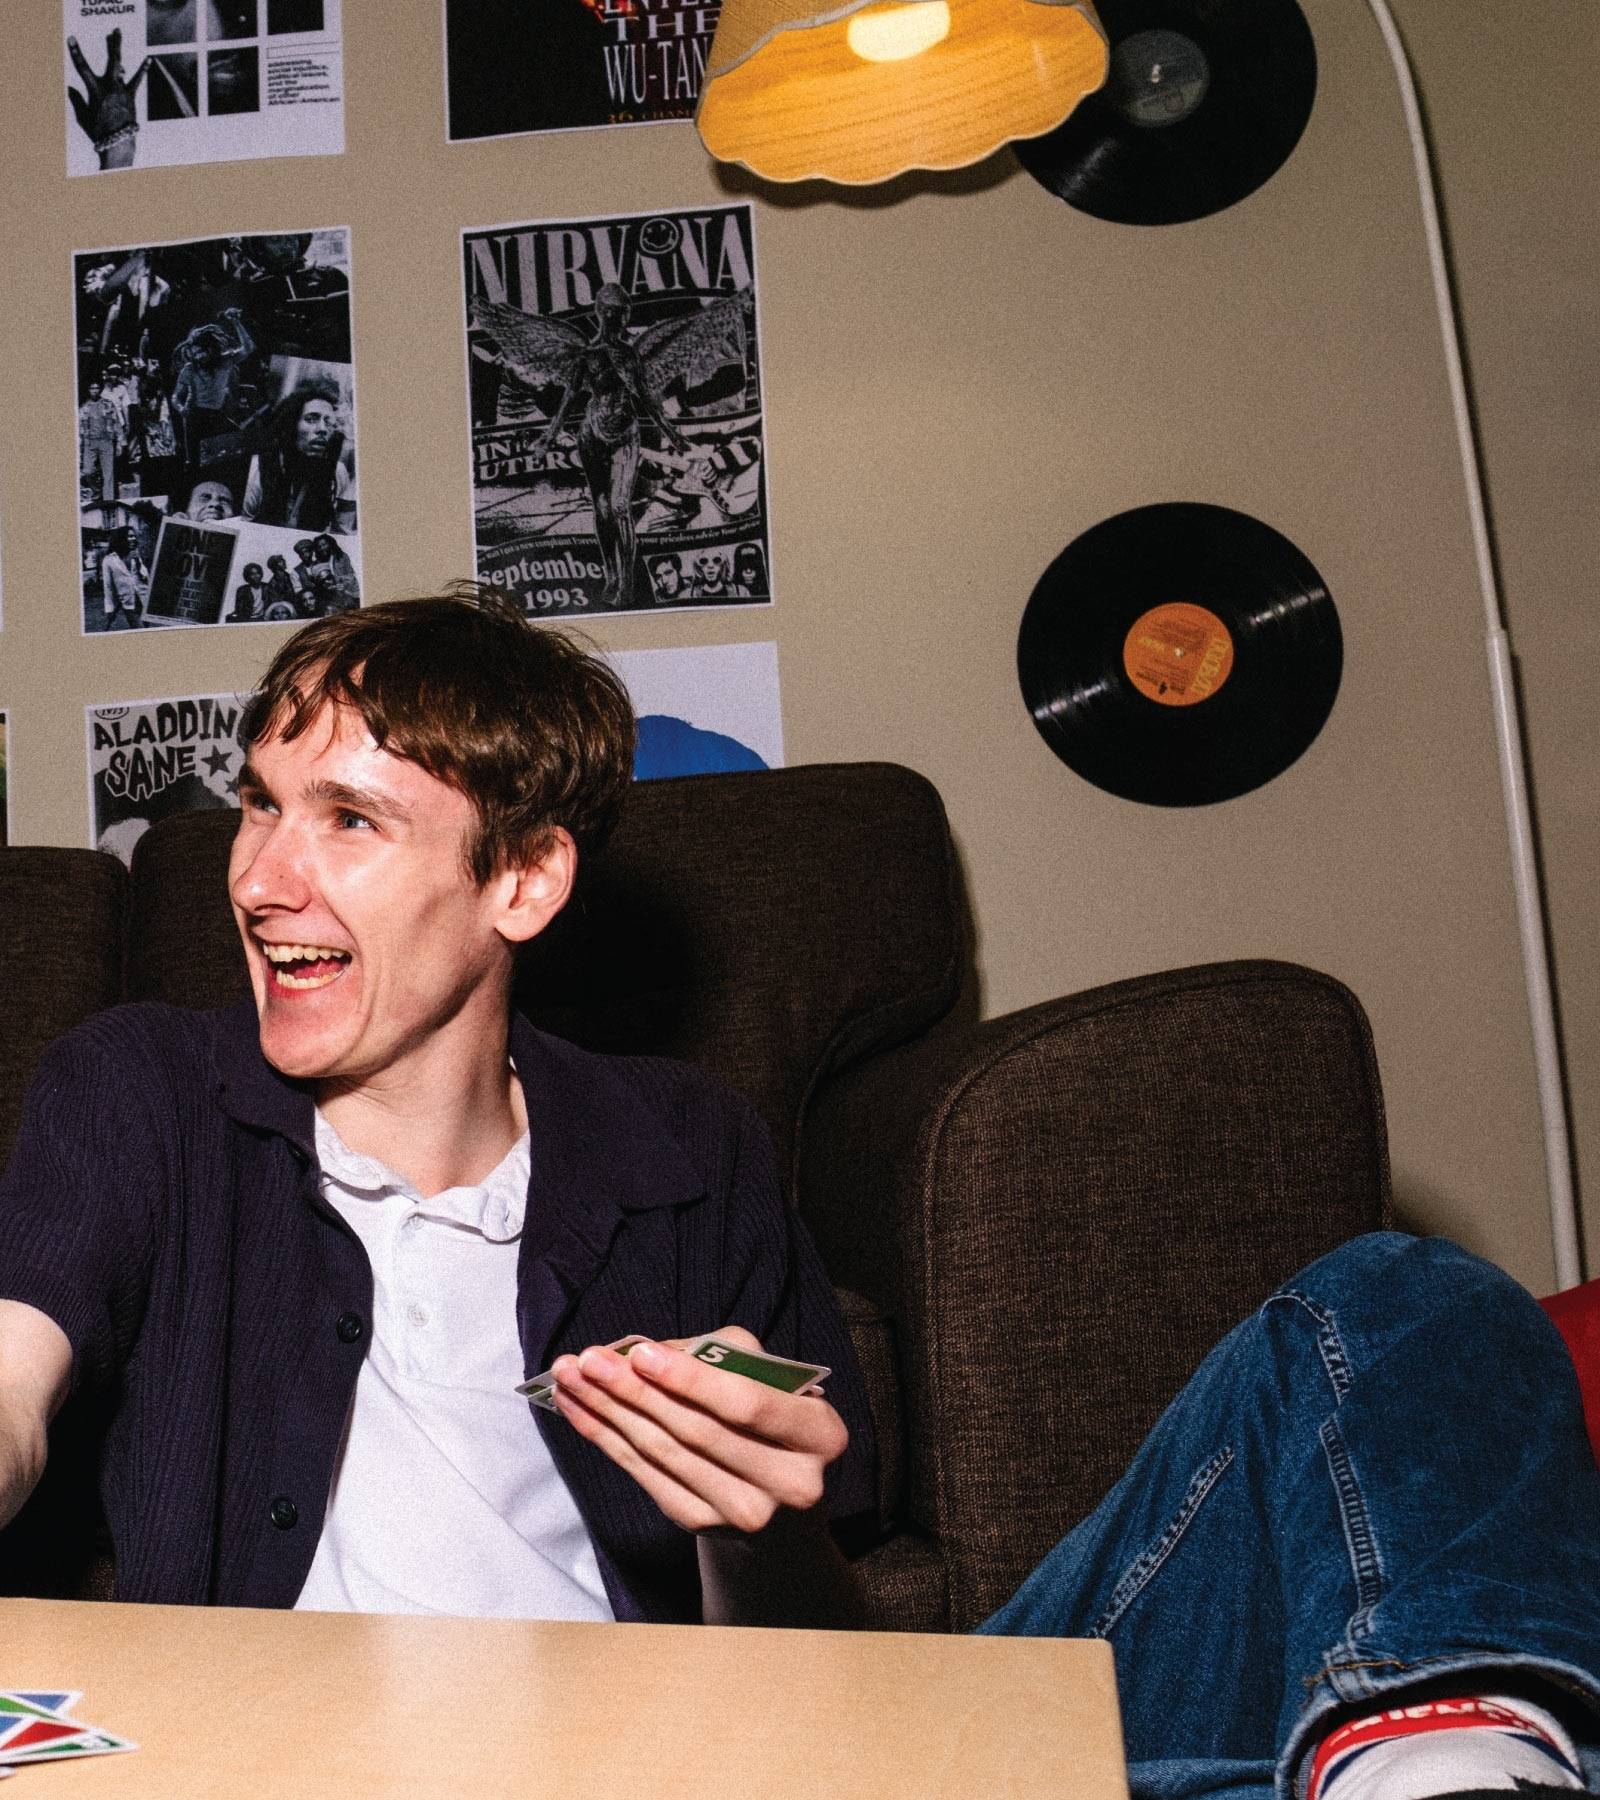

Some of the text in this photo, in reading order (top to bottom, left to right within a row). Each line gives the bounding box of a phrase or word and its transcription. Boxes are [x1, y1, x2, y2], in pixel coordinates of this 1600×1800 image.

[81, 4, 135, 17] SHAKUR
[603, 8, 721, 41] THE
[603, 36, 709, 105] WU-TAN
[467, 214, 752, 316] NIRVANA
[478, 439, 512, 463] IN
[524, 587, 589, 611] 1993
[94, 699, 238, 751] ALADDIN
[107, 745, 196, 800] SANE
[699, 1346, 730, 1363] 5
